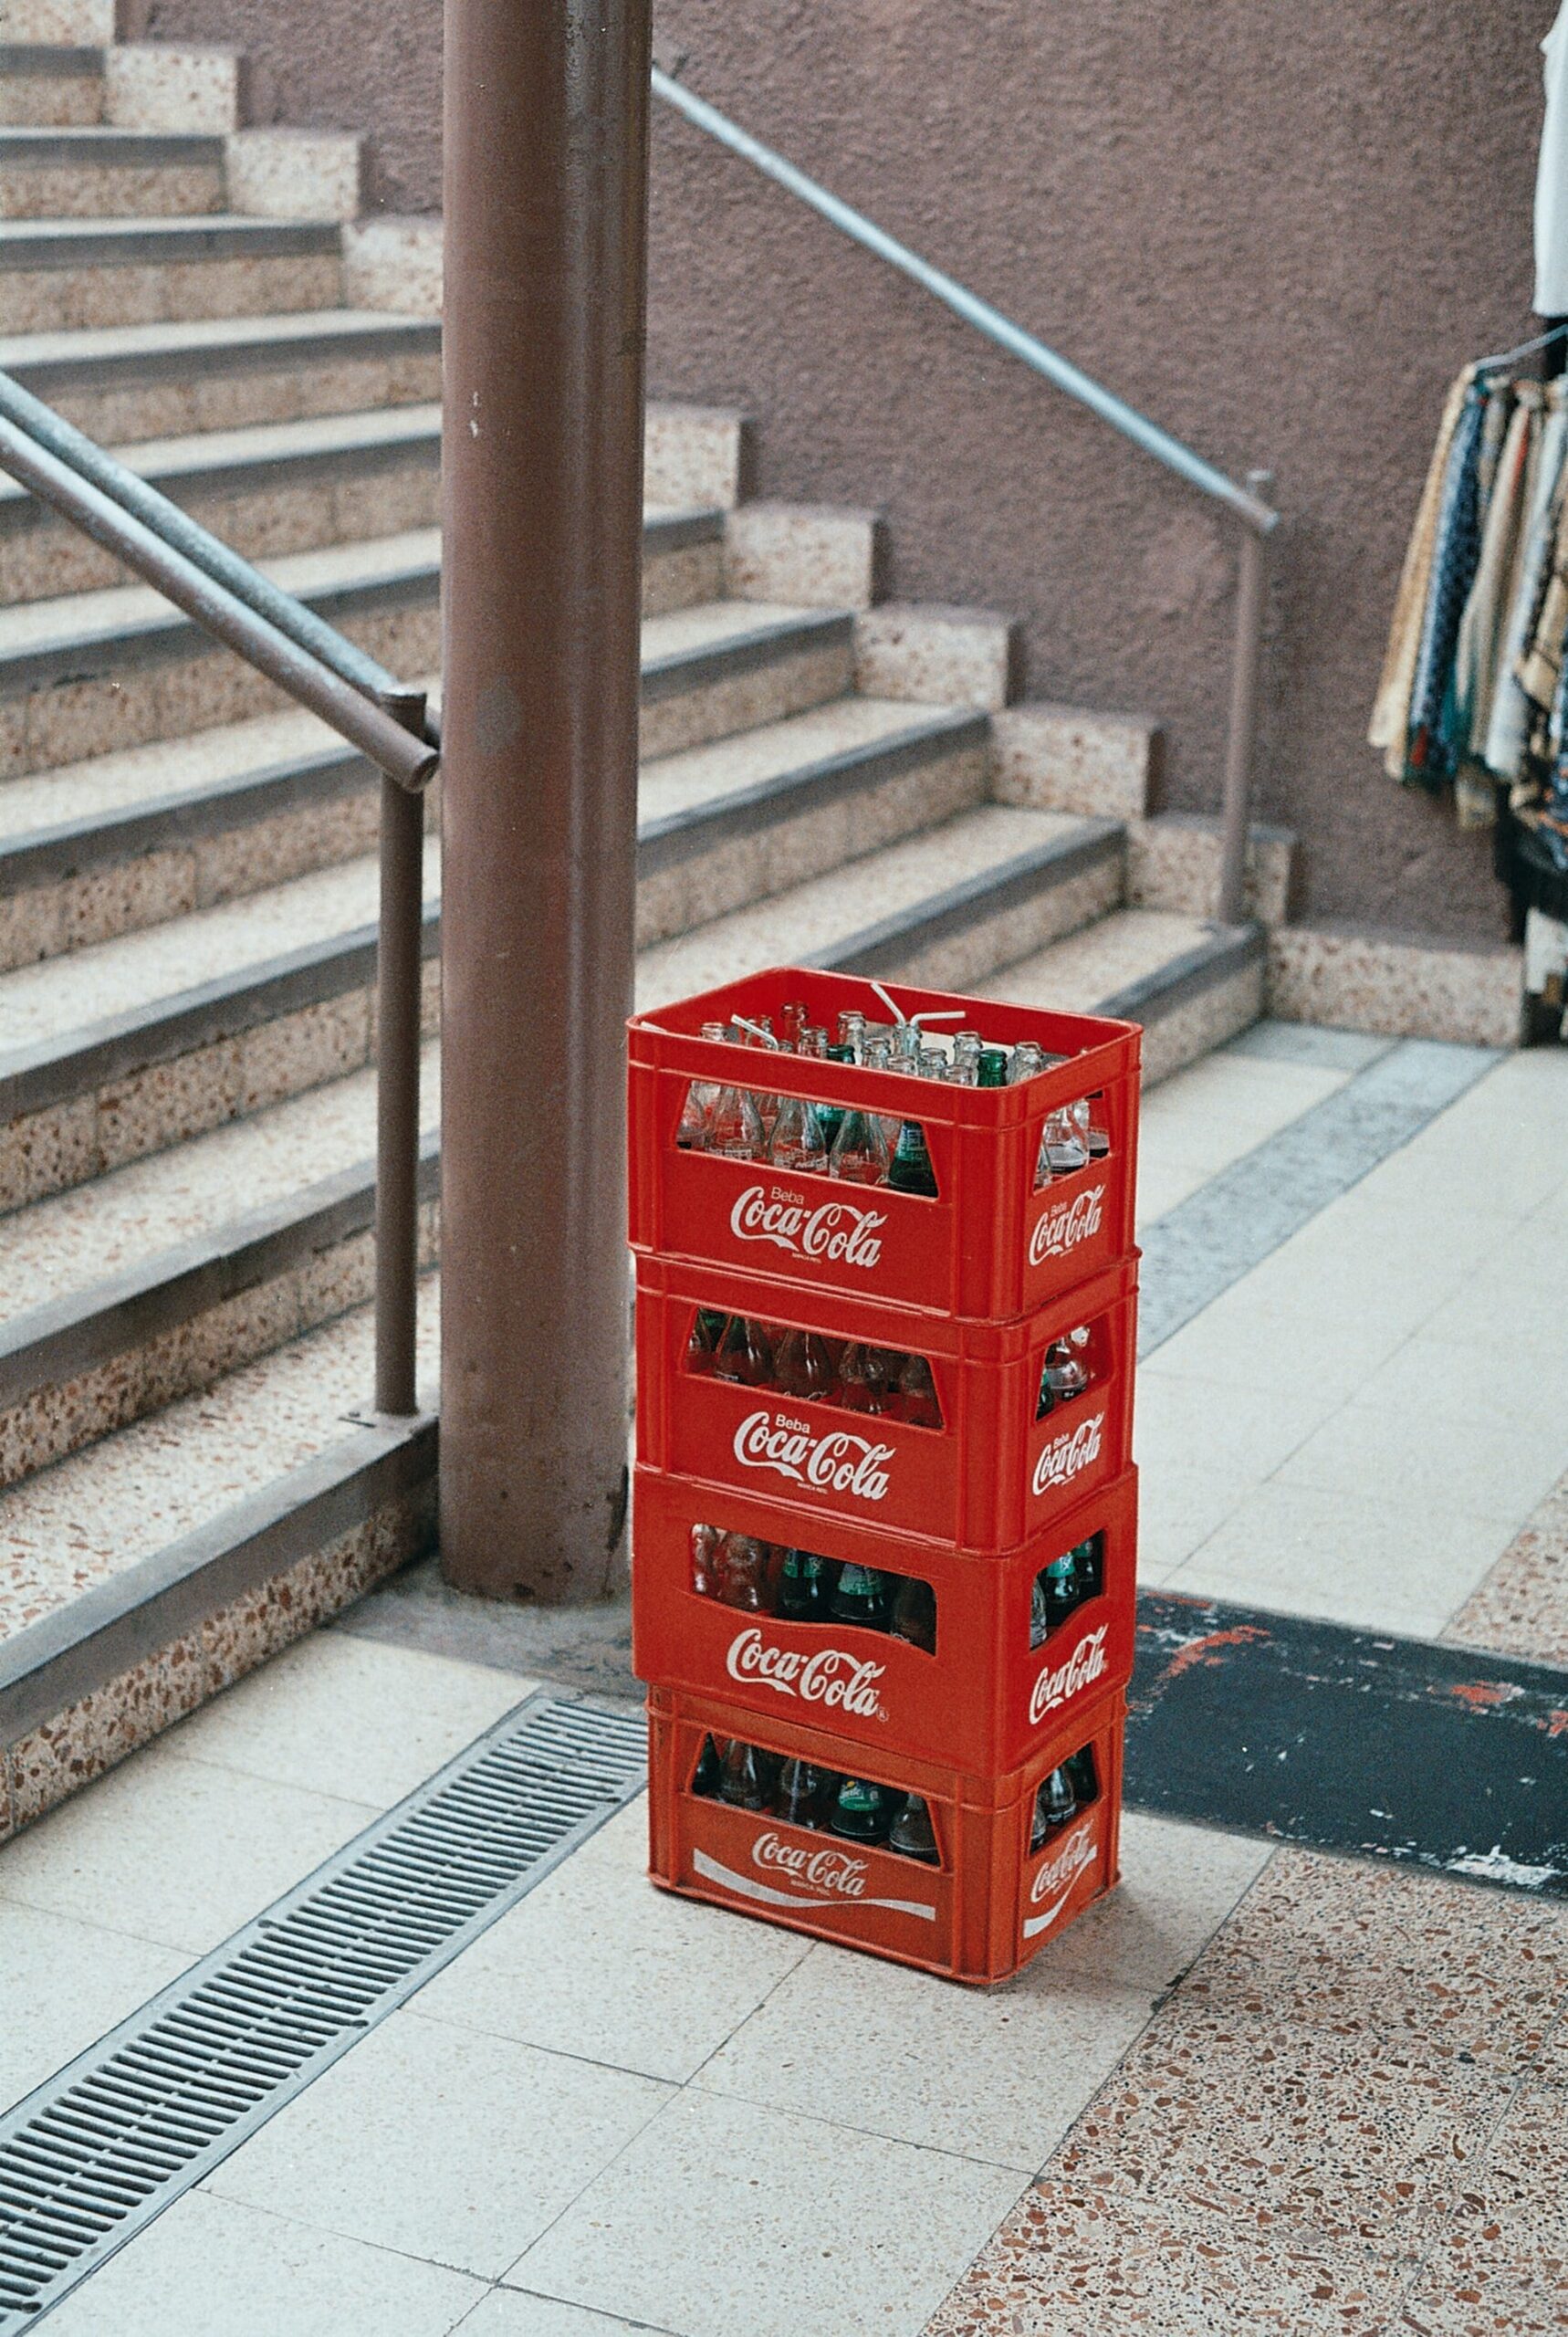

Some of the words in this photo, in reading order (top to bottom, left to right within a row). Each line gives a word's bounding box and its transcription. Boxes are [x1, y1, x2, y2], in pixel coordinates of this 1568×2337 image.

[731, 1186, 888, 1268] Coca-Cola
[770, 1187, 804, 1205] Beba
[1029, 1184, 1106, 1266] Coca-Cola
[734, 1411, 896, 1500] Coca-Cola
[776, 1414, 810, 1434] Beba
[1032, 1411, 1105, 1496] Coca-Cola
[727, 1629, 886, 1716] Coca-Cola
[1029, 1622, 1109, 1725] Coca-Cola
[752, 1832, 869, 1897] Coca-Cola
